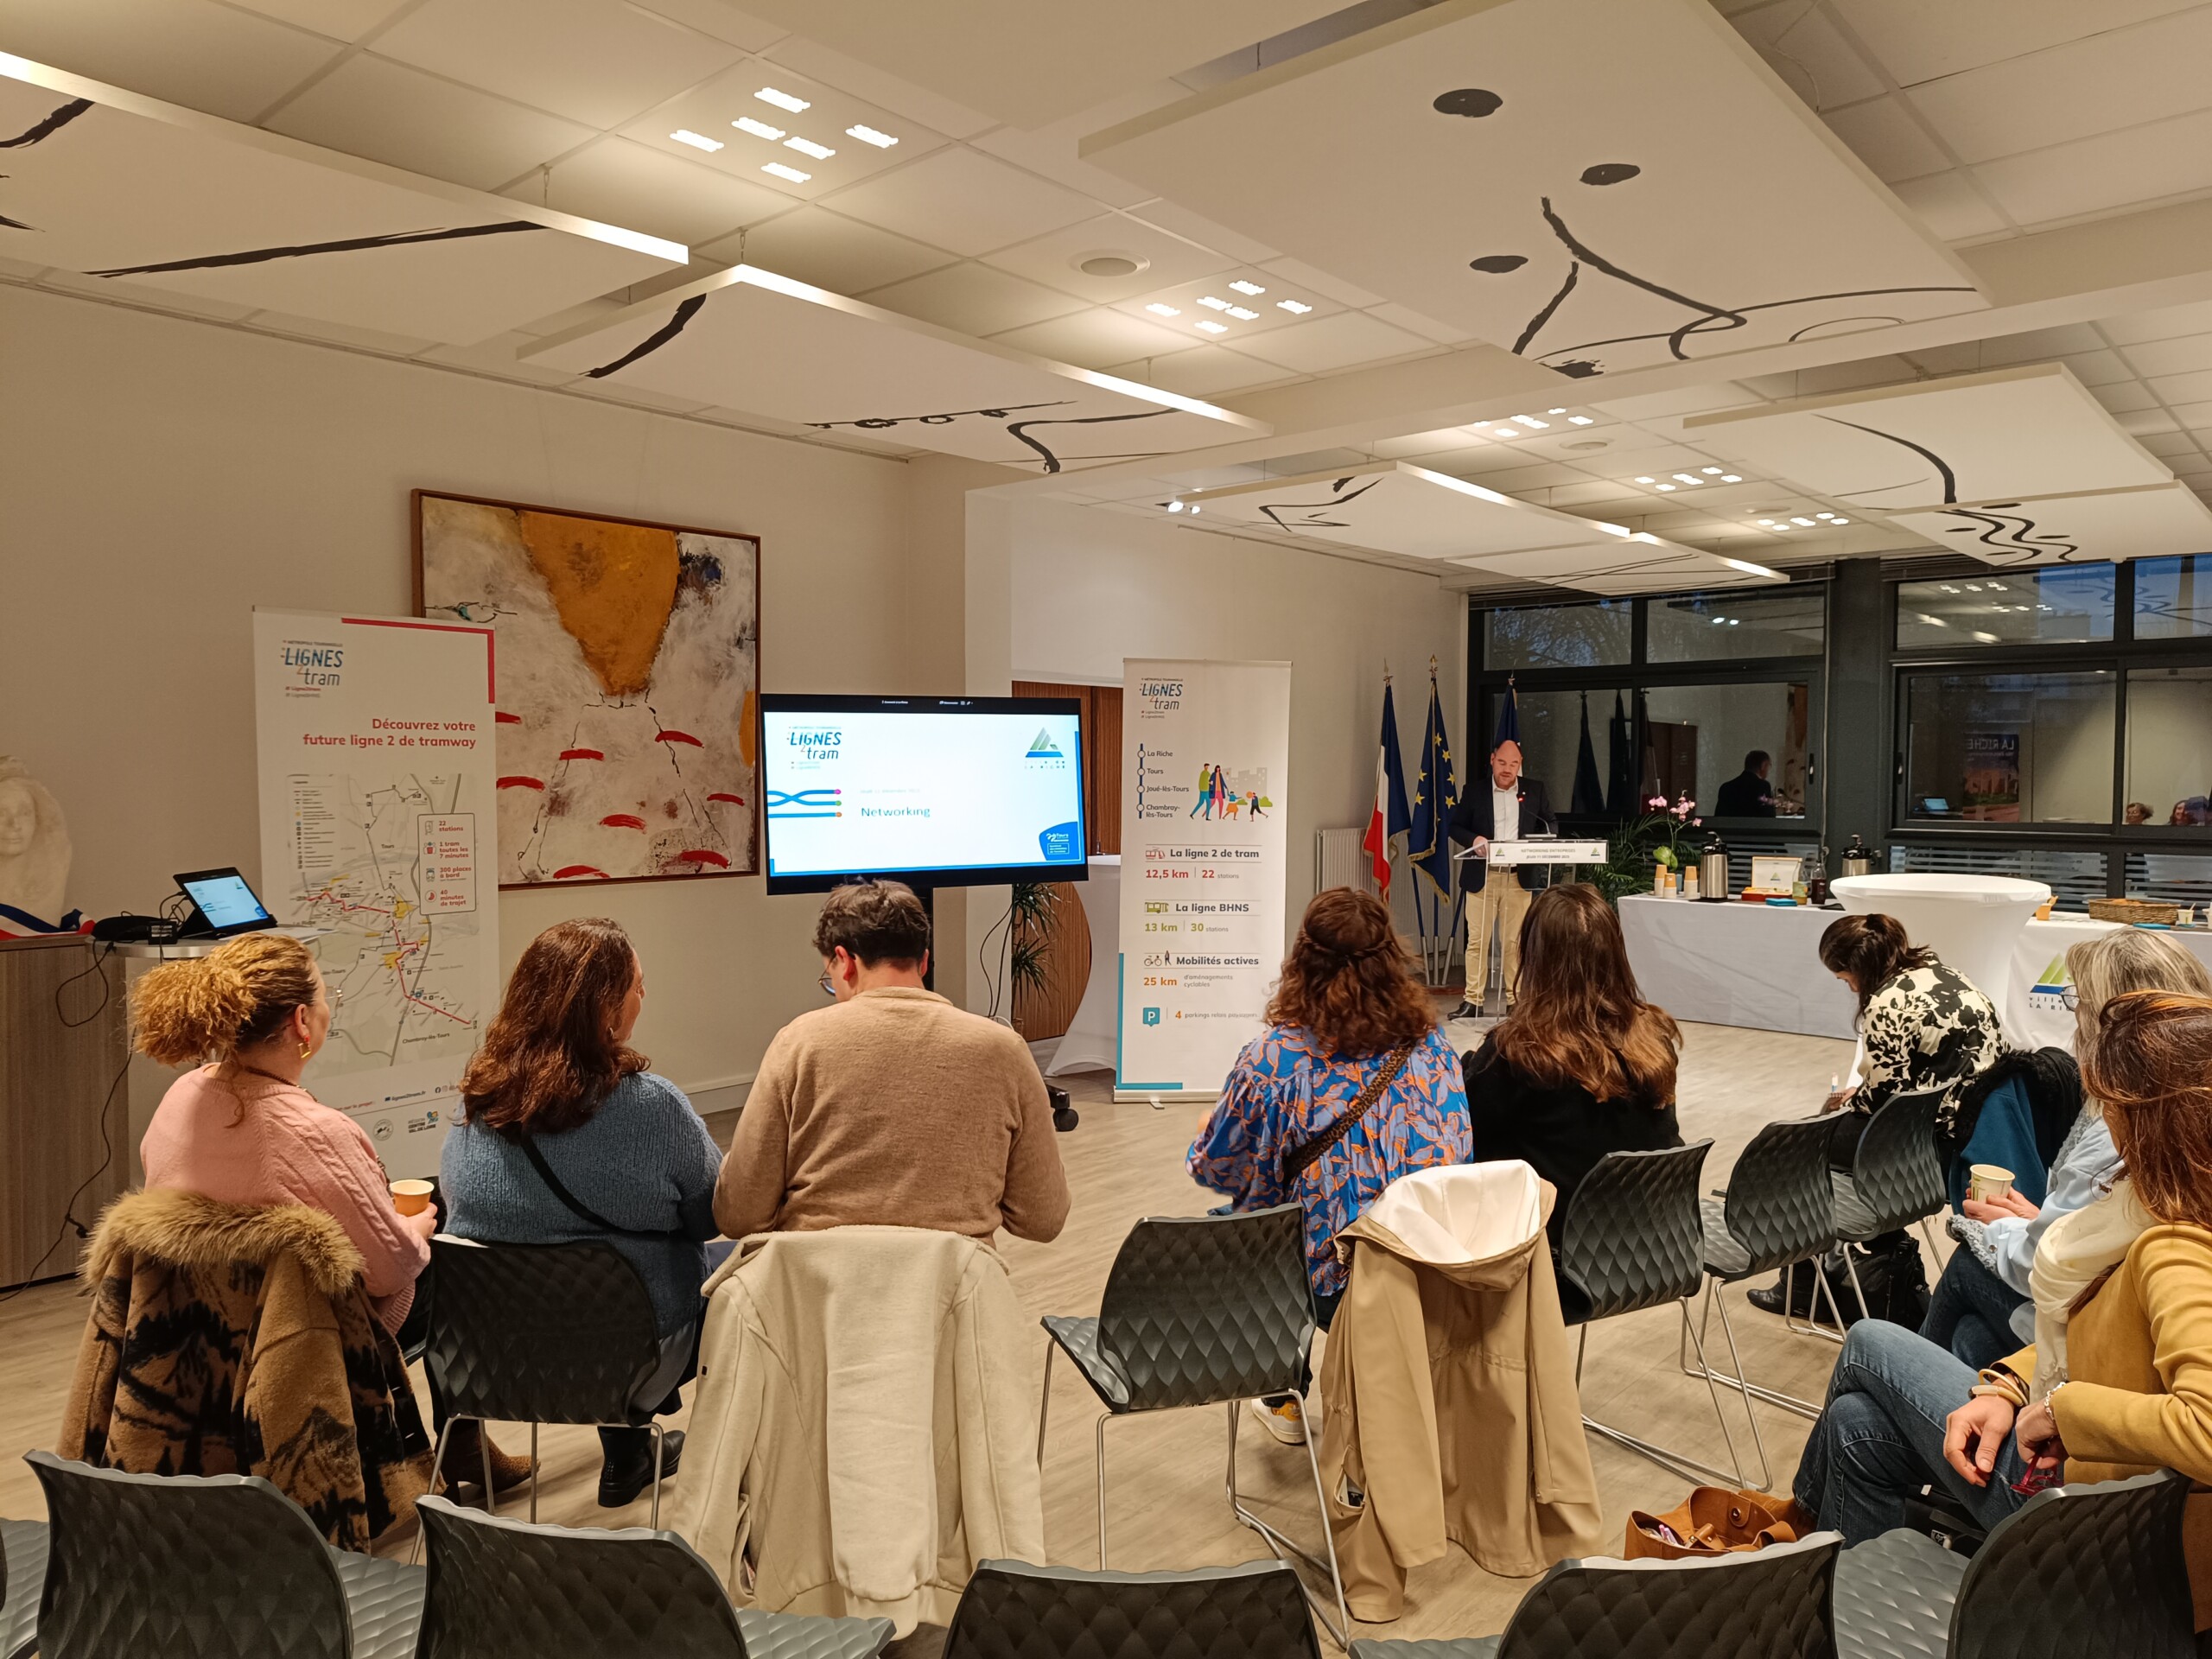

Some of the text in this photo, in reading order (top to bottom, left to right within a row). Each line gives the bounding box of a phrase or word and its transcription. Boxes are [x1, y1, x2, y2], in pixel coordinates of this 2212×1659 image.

[284, 647, 343, 668] LIGNES
[1142, 683, 1183, 696] LIGNES
[372, 718, 476, 731] Découvrez votre
[303, 734, 476, 749] future ligne 2 de tramway
[790, 732, 842, 746] LIGNES
[861, 807, 931, 817] Networking
[1170, 849, 1182, 857] La
[1185, 849, 1208, 859] ligne
[1146, 869, 1169, 880] 12,5
[1172, 869, 1189, 878] km
[1202, 869, 1214, 878] 22
[1175, 903, 1249, 913] La ligne BHNS
[1145, 923, 1157, 931] 13
[1160, 923, 1178, 931] km
[1191, 923, 1204, 931] 30
[1176, 956, 1259, 965] Mobilités actives
[1143, 976, 1177, 986] 25 km
[1175, 1010, 1182, 1019] 4
